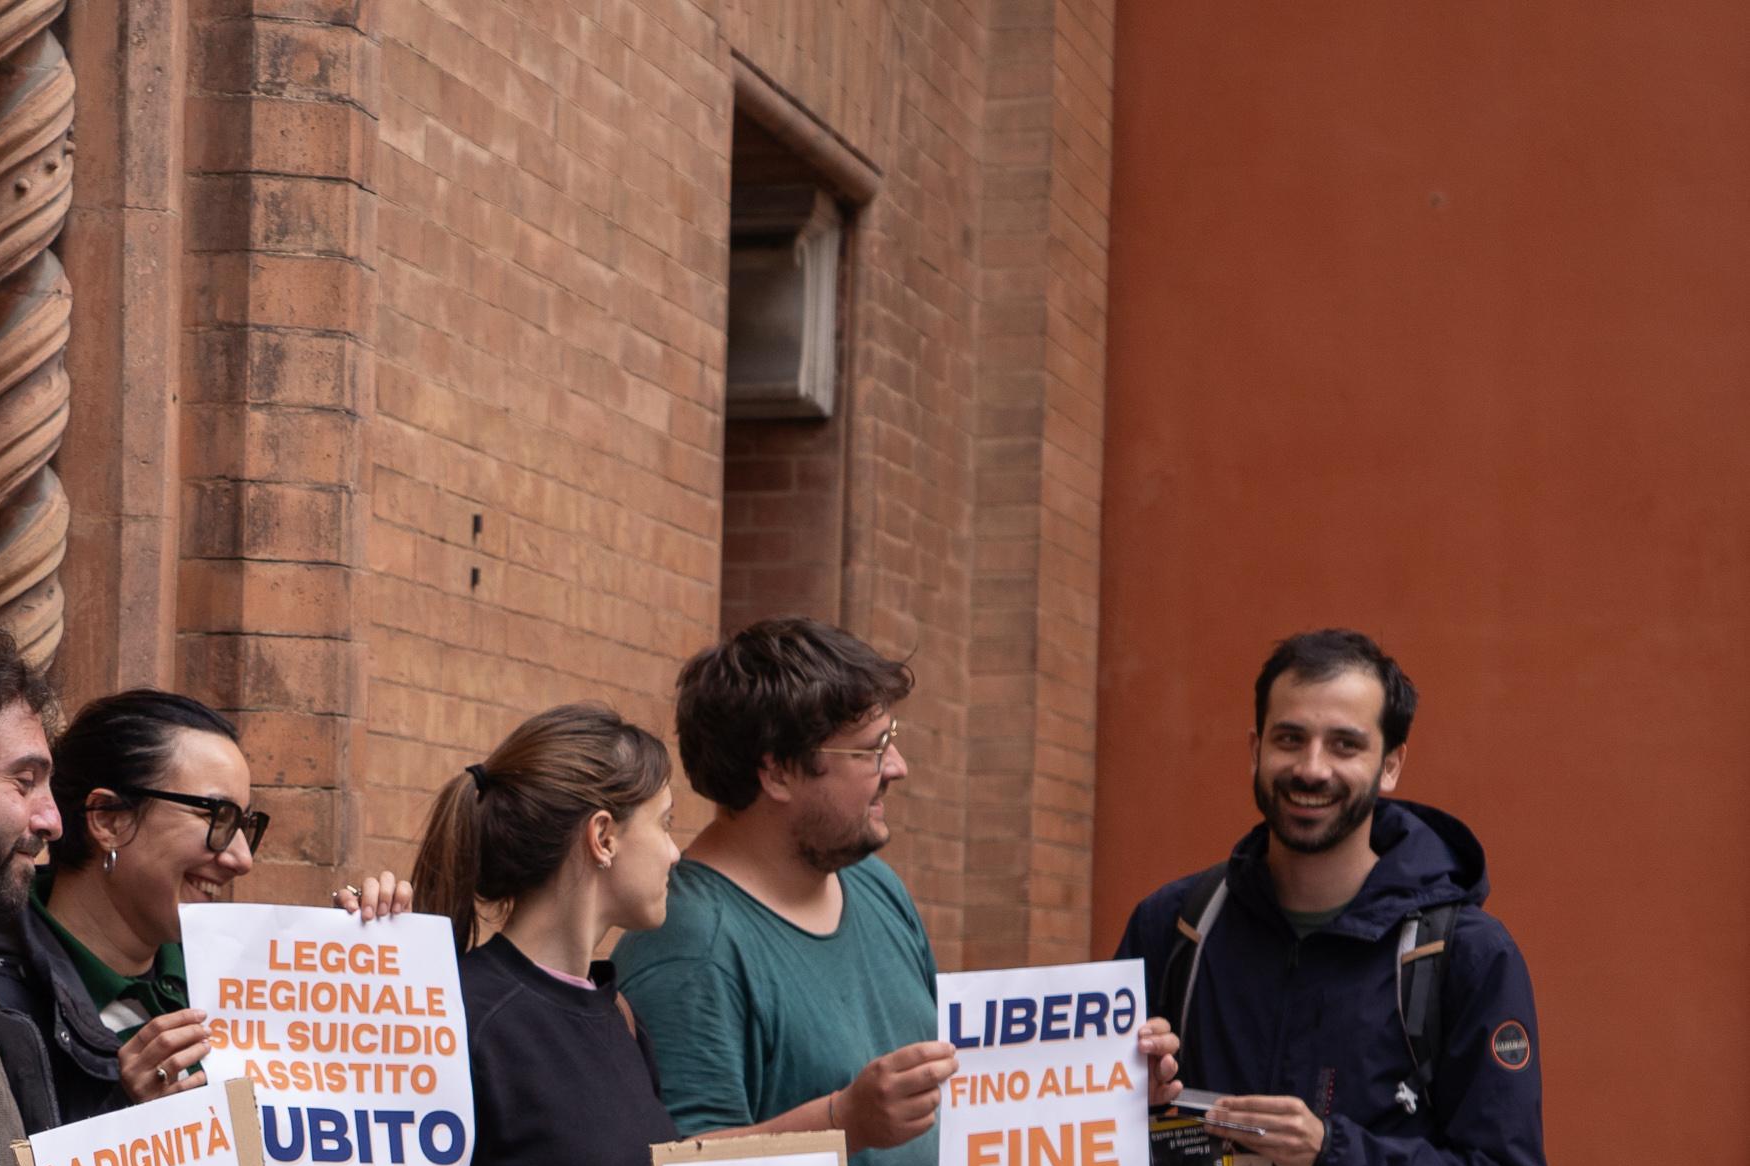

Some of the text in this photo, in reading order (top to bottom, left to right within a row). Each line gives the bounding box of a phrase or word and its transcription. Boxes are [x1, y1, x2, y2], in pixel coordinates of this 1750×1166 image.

[269, 939, 400, 976] LEGGE
[219, 978, 446, 1017] REGIONALE
[208, 1017, 457, 1056] SUL SUICIDIO
[245, 1060, 437, 1095] ASSISTITO
[950, 1062, 1134, 1106] FINO ALLA
[261, 1105, 466, 1165] UBITO
